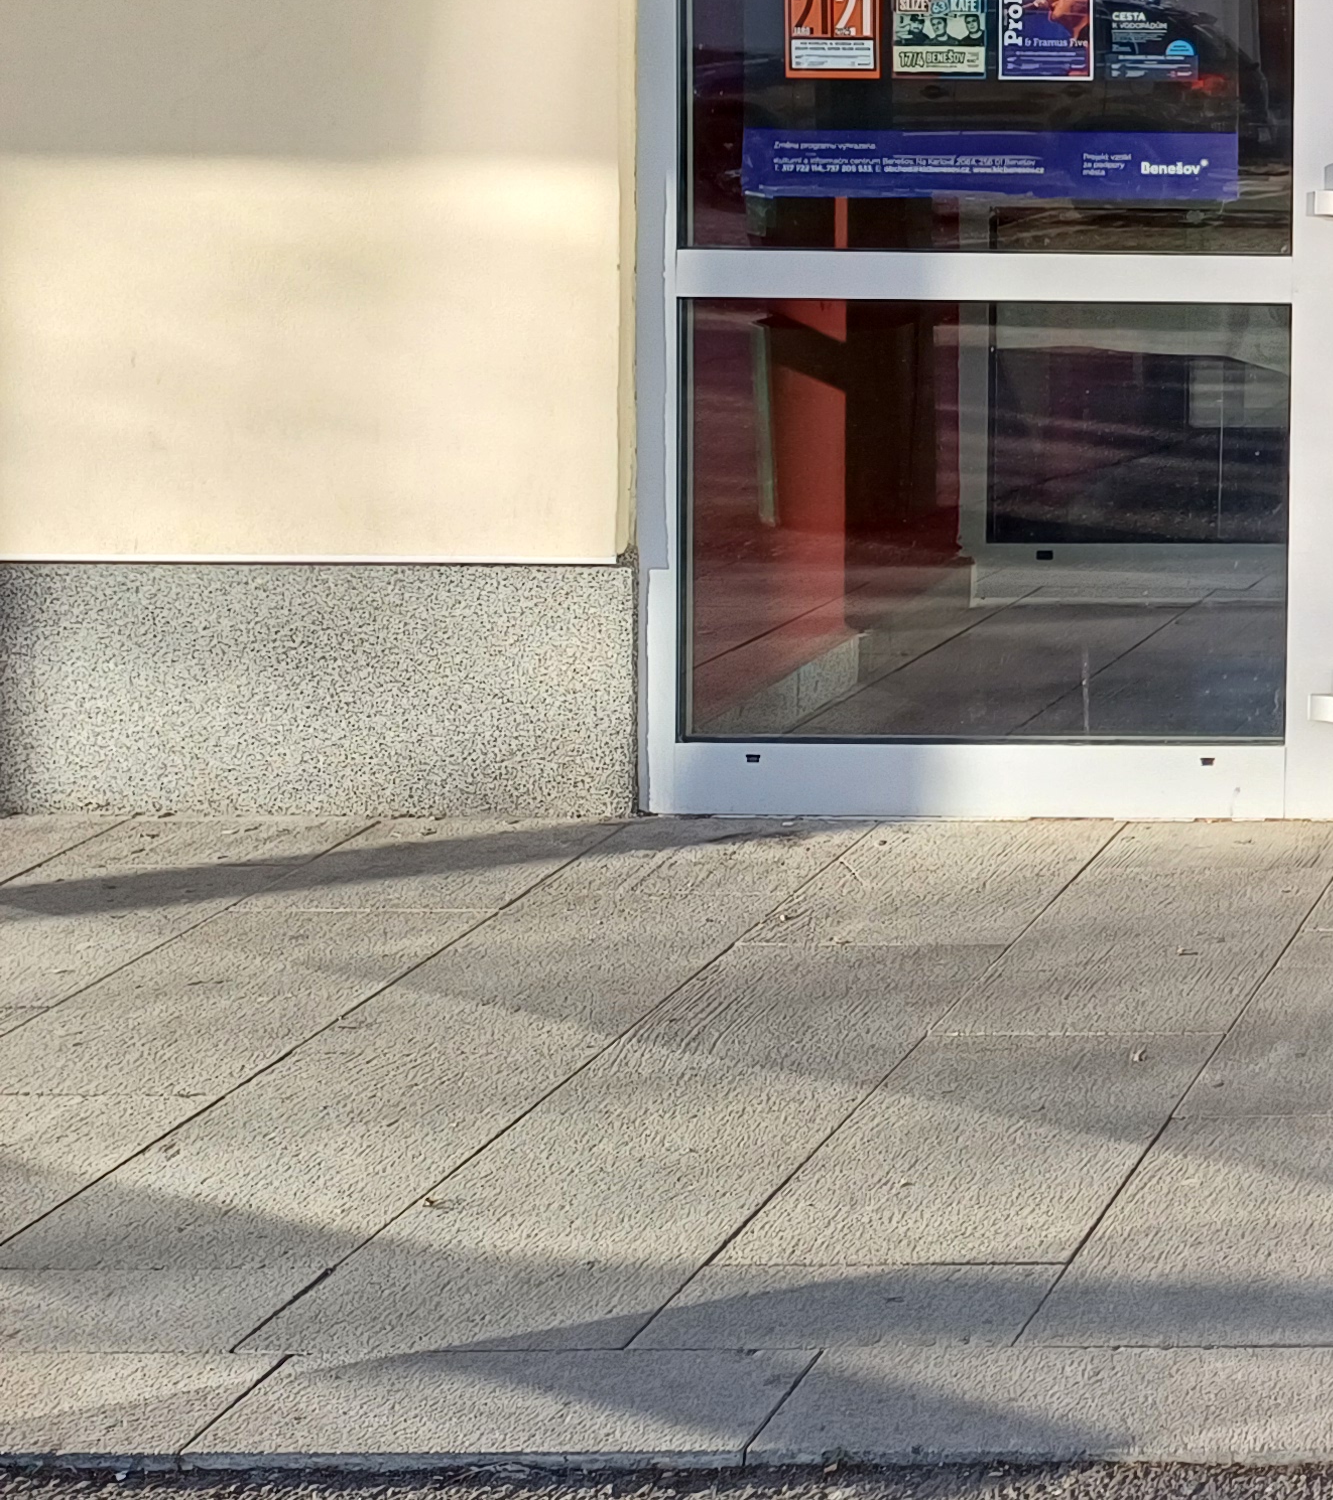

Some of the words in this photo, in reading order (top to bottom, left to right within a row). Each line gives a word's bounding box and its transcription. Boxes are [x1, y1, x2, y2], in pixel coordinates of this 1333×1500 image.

[1112, 12, 1145, 21] CESTA
[1034, 38, 1067, 46] Framus
[1070, 38, 1088, 46] Five
[1141, 162, 1200, 174] Benešov
